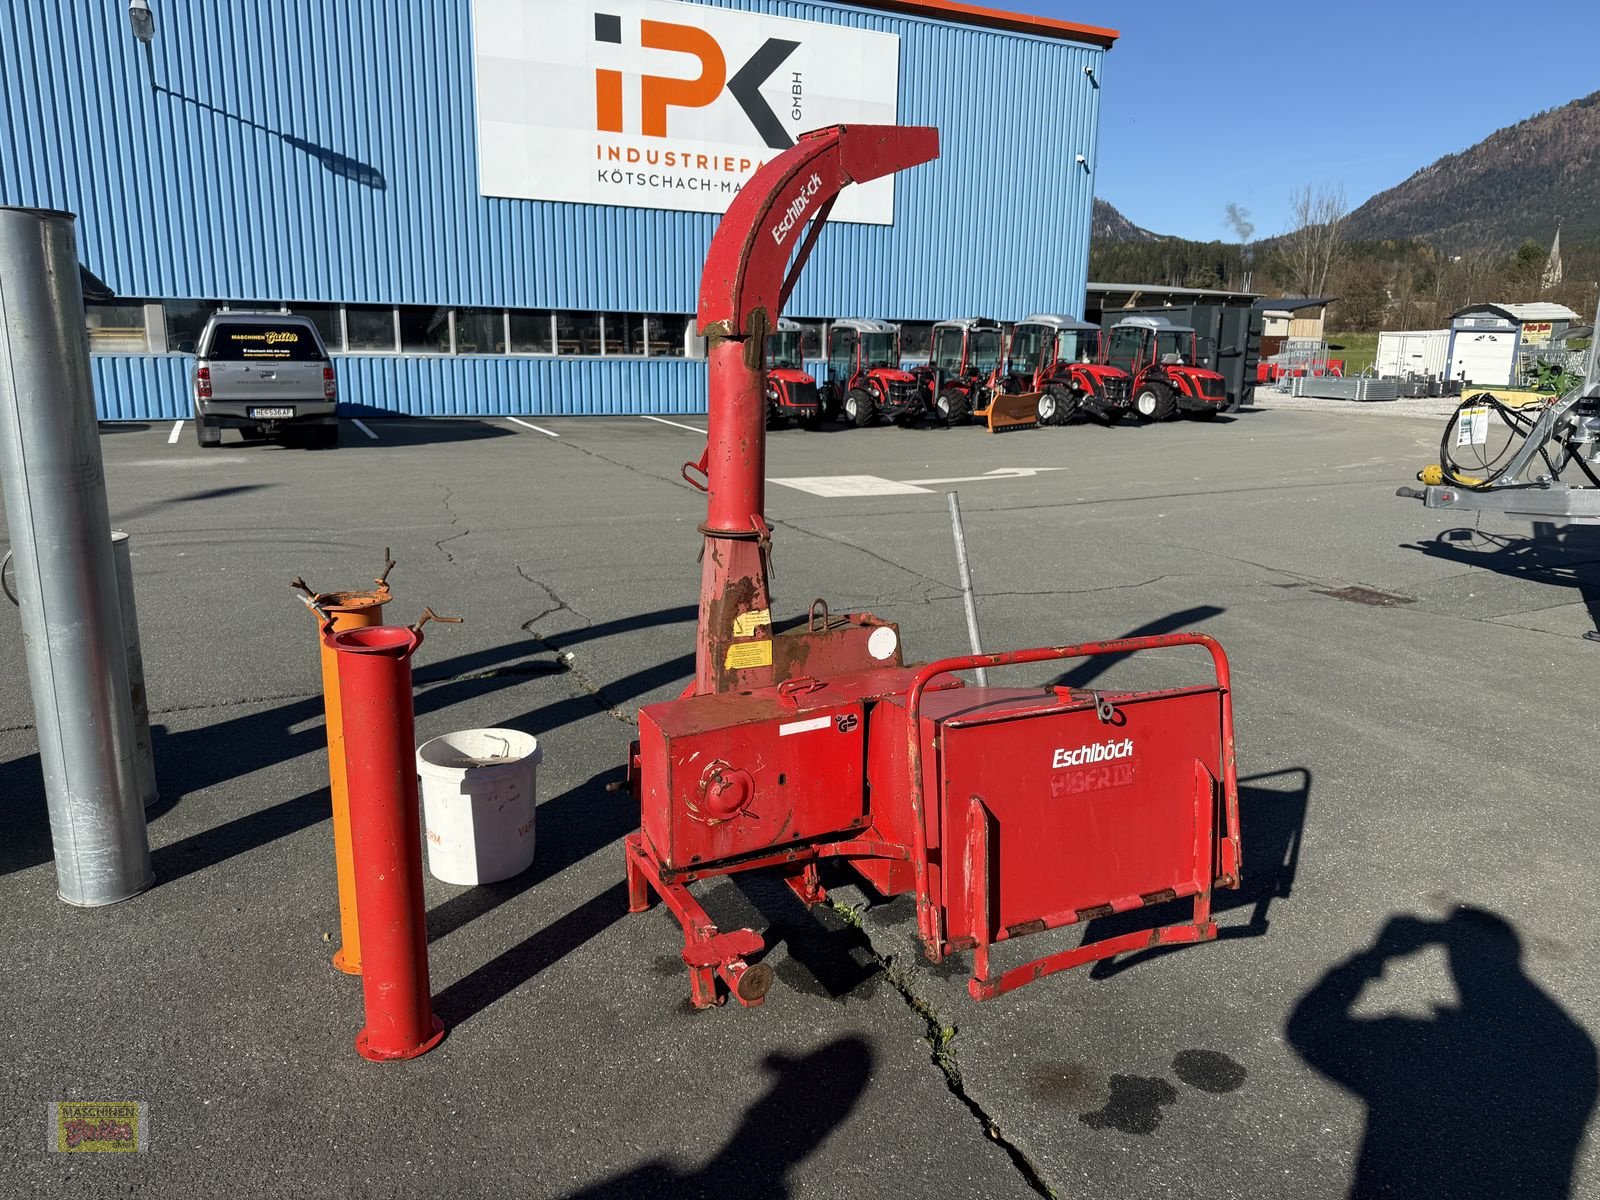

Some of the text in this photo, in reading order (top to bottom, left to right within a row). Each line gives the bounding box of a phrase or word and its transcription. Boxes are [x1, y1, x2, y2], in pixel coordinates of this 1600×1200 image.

[791, 71, 803, 121] GMBH
[837, 713, 858, 733] GS
[1052, 738, 1134, 769] Eschlböck
